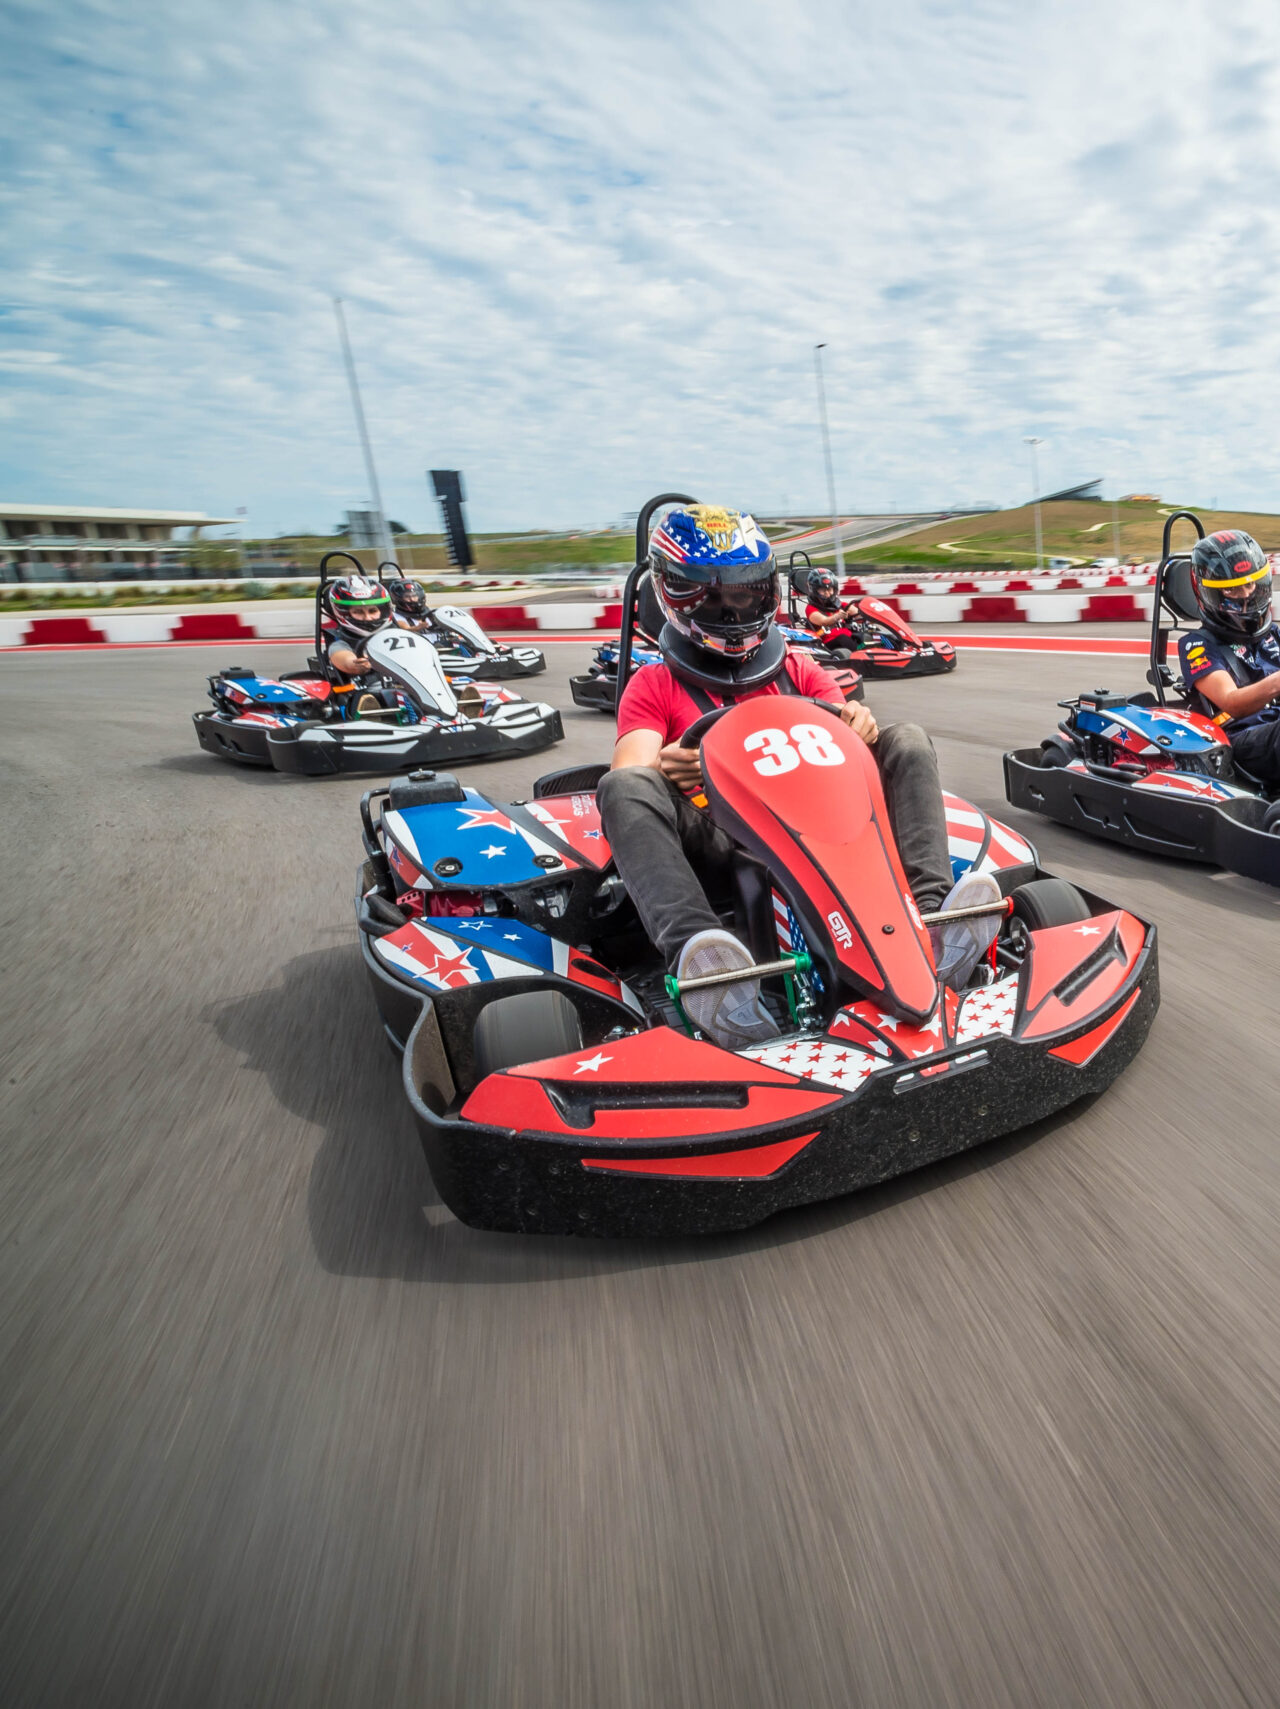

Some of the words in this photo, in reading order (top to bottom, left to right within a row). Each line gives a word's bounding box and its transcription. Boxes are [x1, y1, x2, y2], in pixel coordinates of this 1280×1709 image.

[383, 636, 416, 652] 27
[743, 723, 846, 777] 38
[827, 910, 853, 950] GTR
